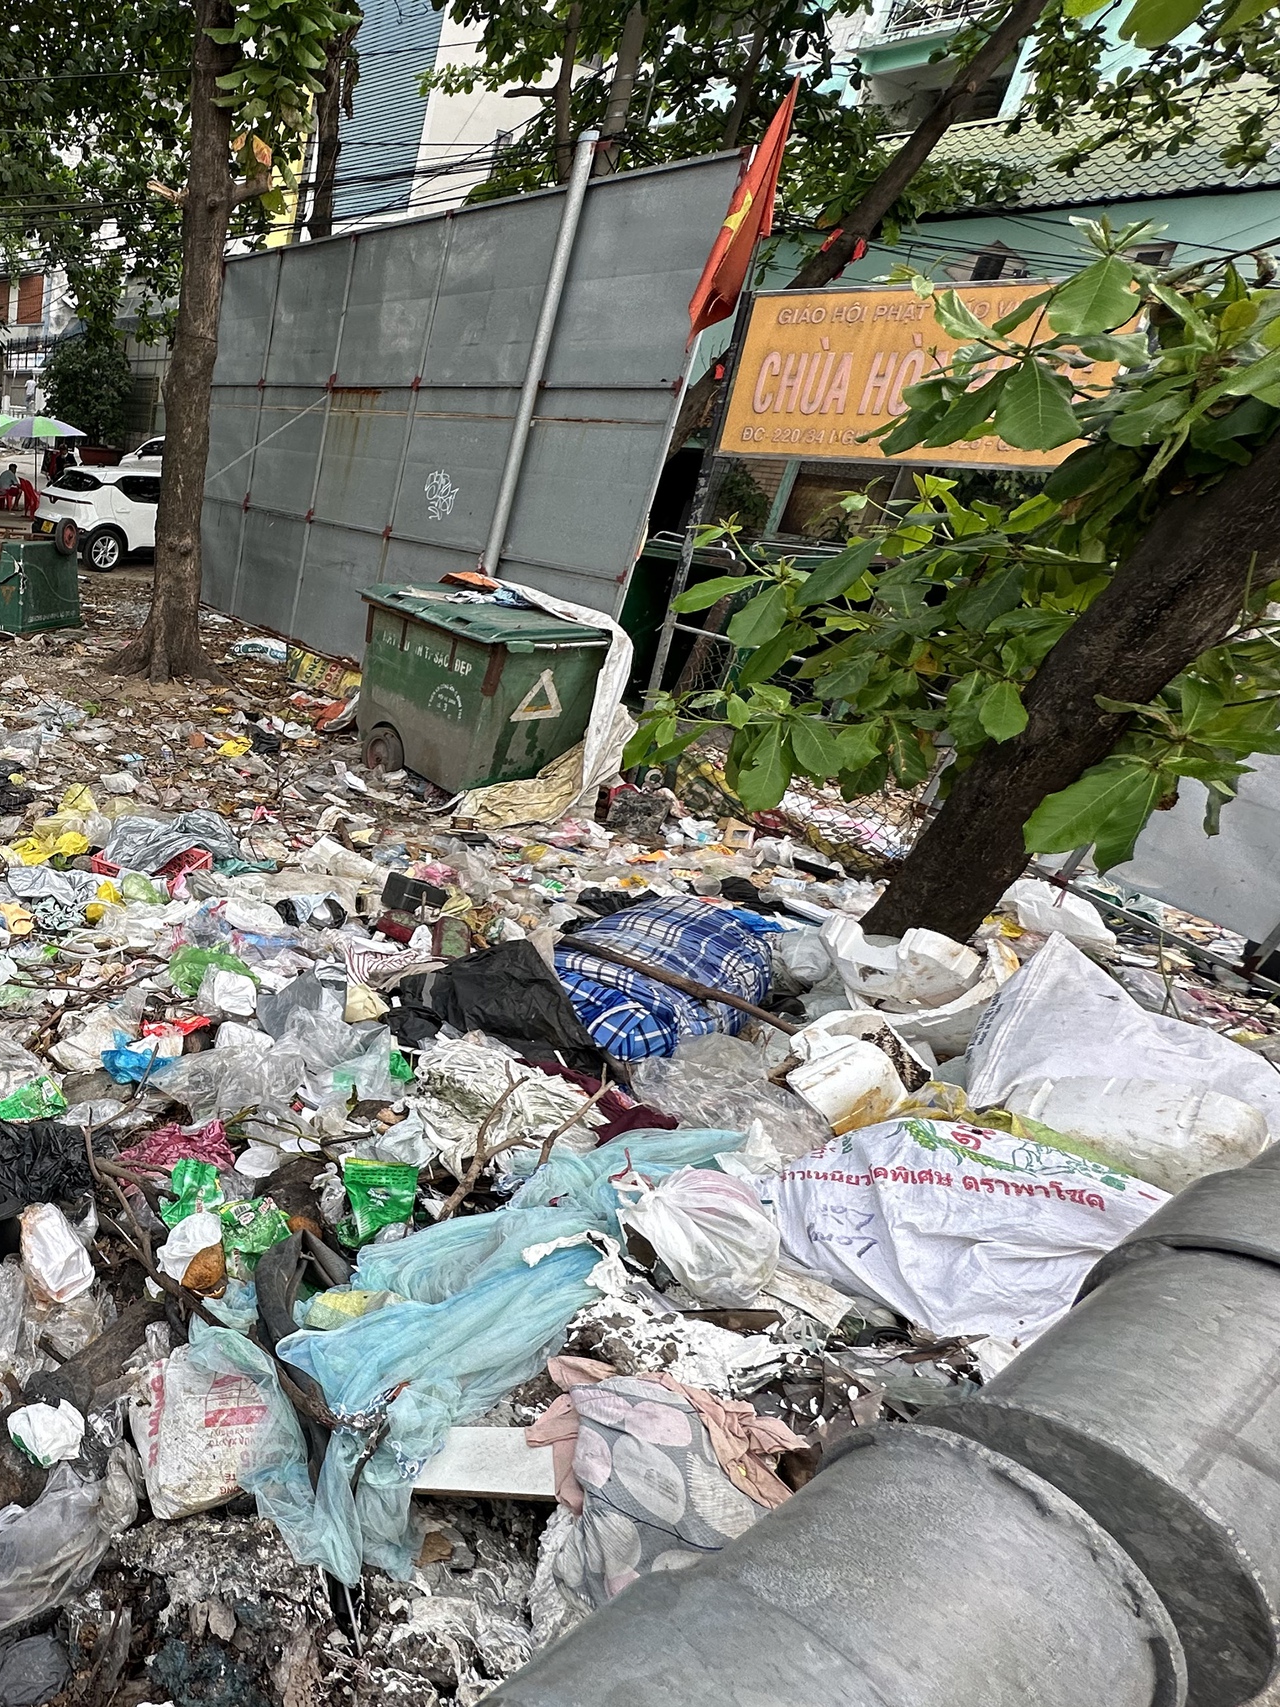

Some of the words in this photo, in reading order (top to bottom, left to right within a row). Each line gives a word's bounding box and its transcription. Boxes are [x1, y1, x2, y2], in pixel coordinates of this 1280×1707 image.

[778, 303, 825, 325] GIÁO
[830, 301, 869, 327] HỘI
[872, 300, 931, 326] PHẬT
[752, 335, 854, 415] CHÙA
[433, 650, 452, 669] SẠC
[454, 657, 473, 677] ĐẸP
